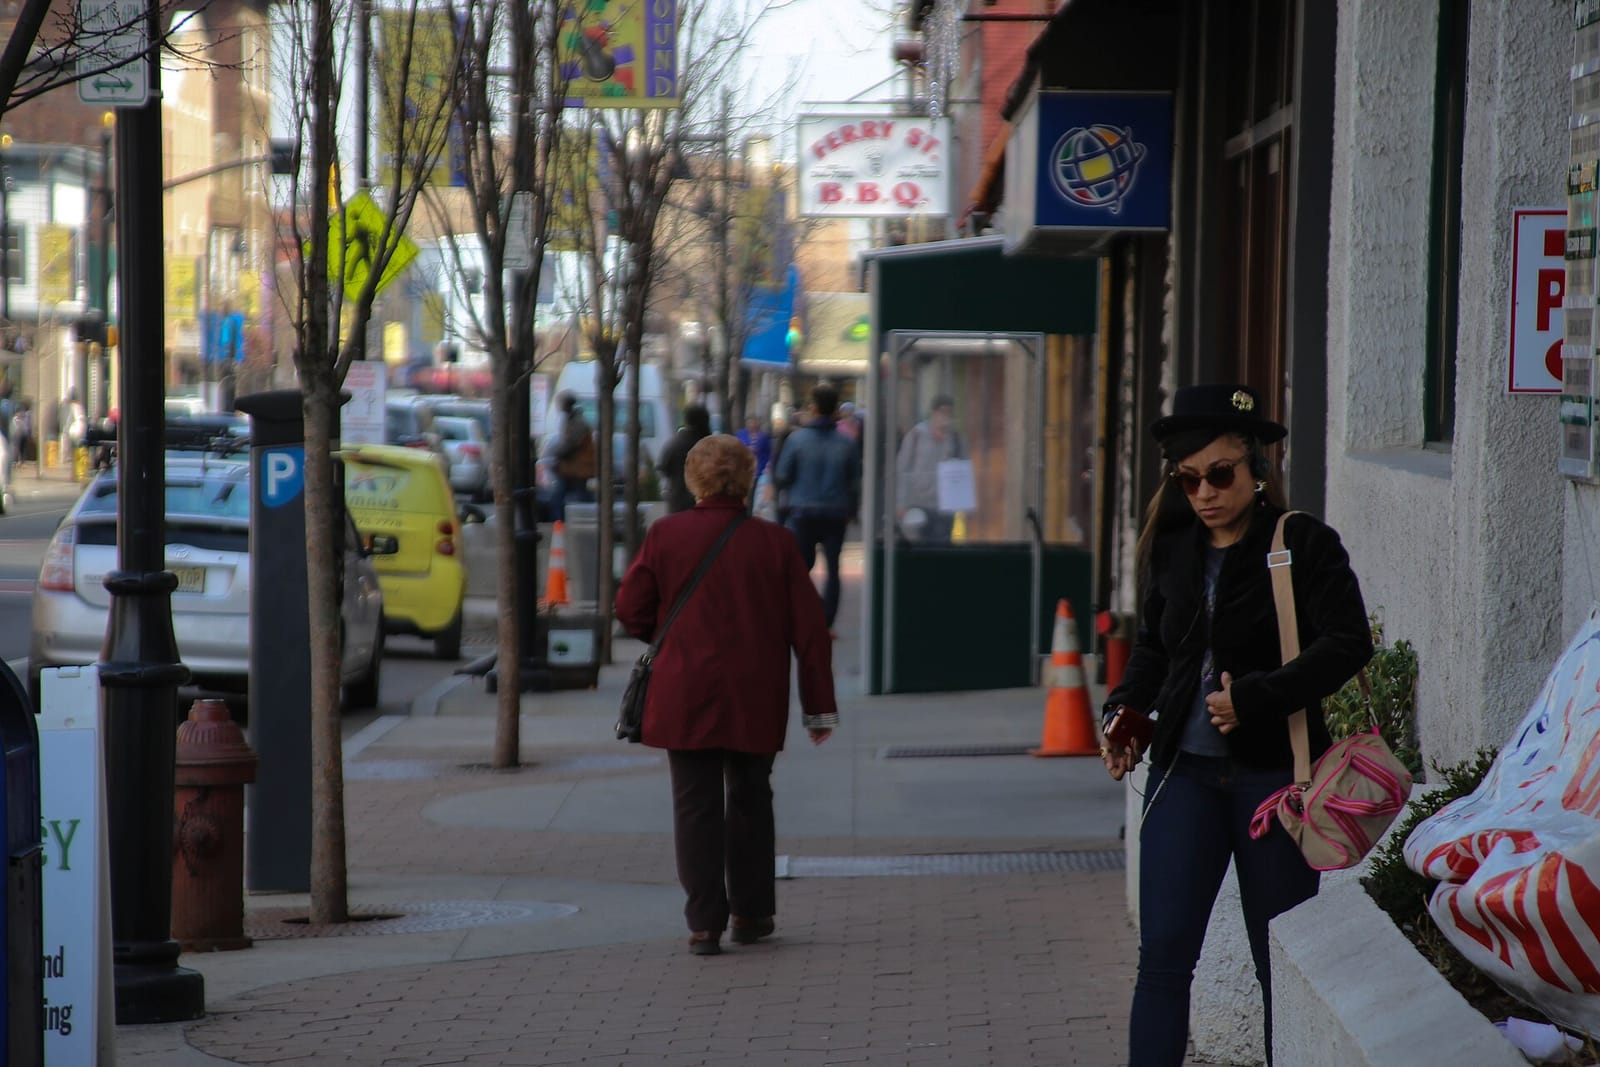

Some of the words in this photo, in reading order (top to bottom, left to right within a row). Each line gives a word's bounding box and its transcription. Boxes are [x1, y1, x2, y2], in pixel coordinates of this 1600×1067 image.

[812, 120, 895, 158] FERRY
[820, 182, 929, 208] B.B.Q.
[267, 453, 295, 497] P
